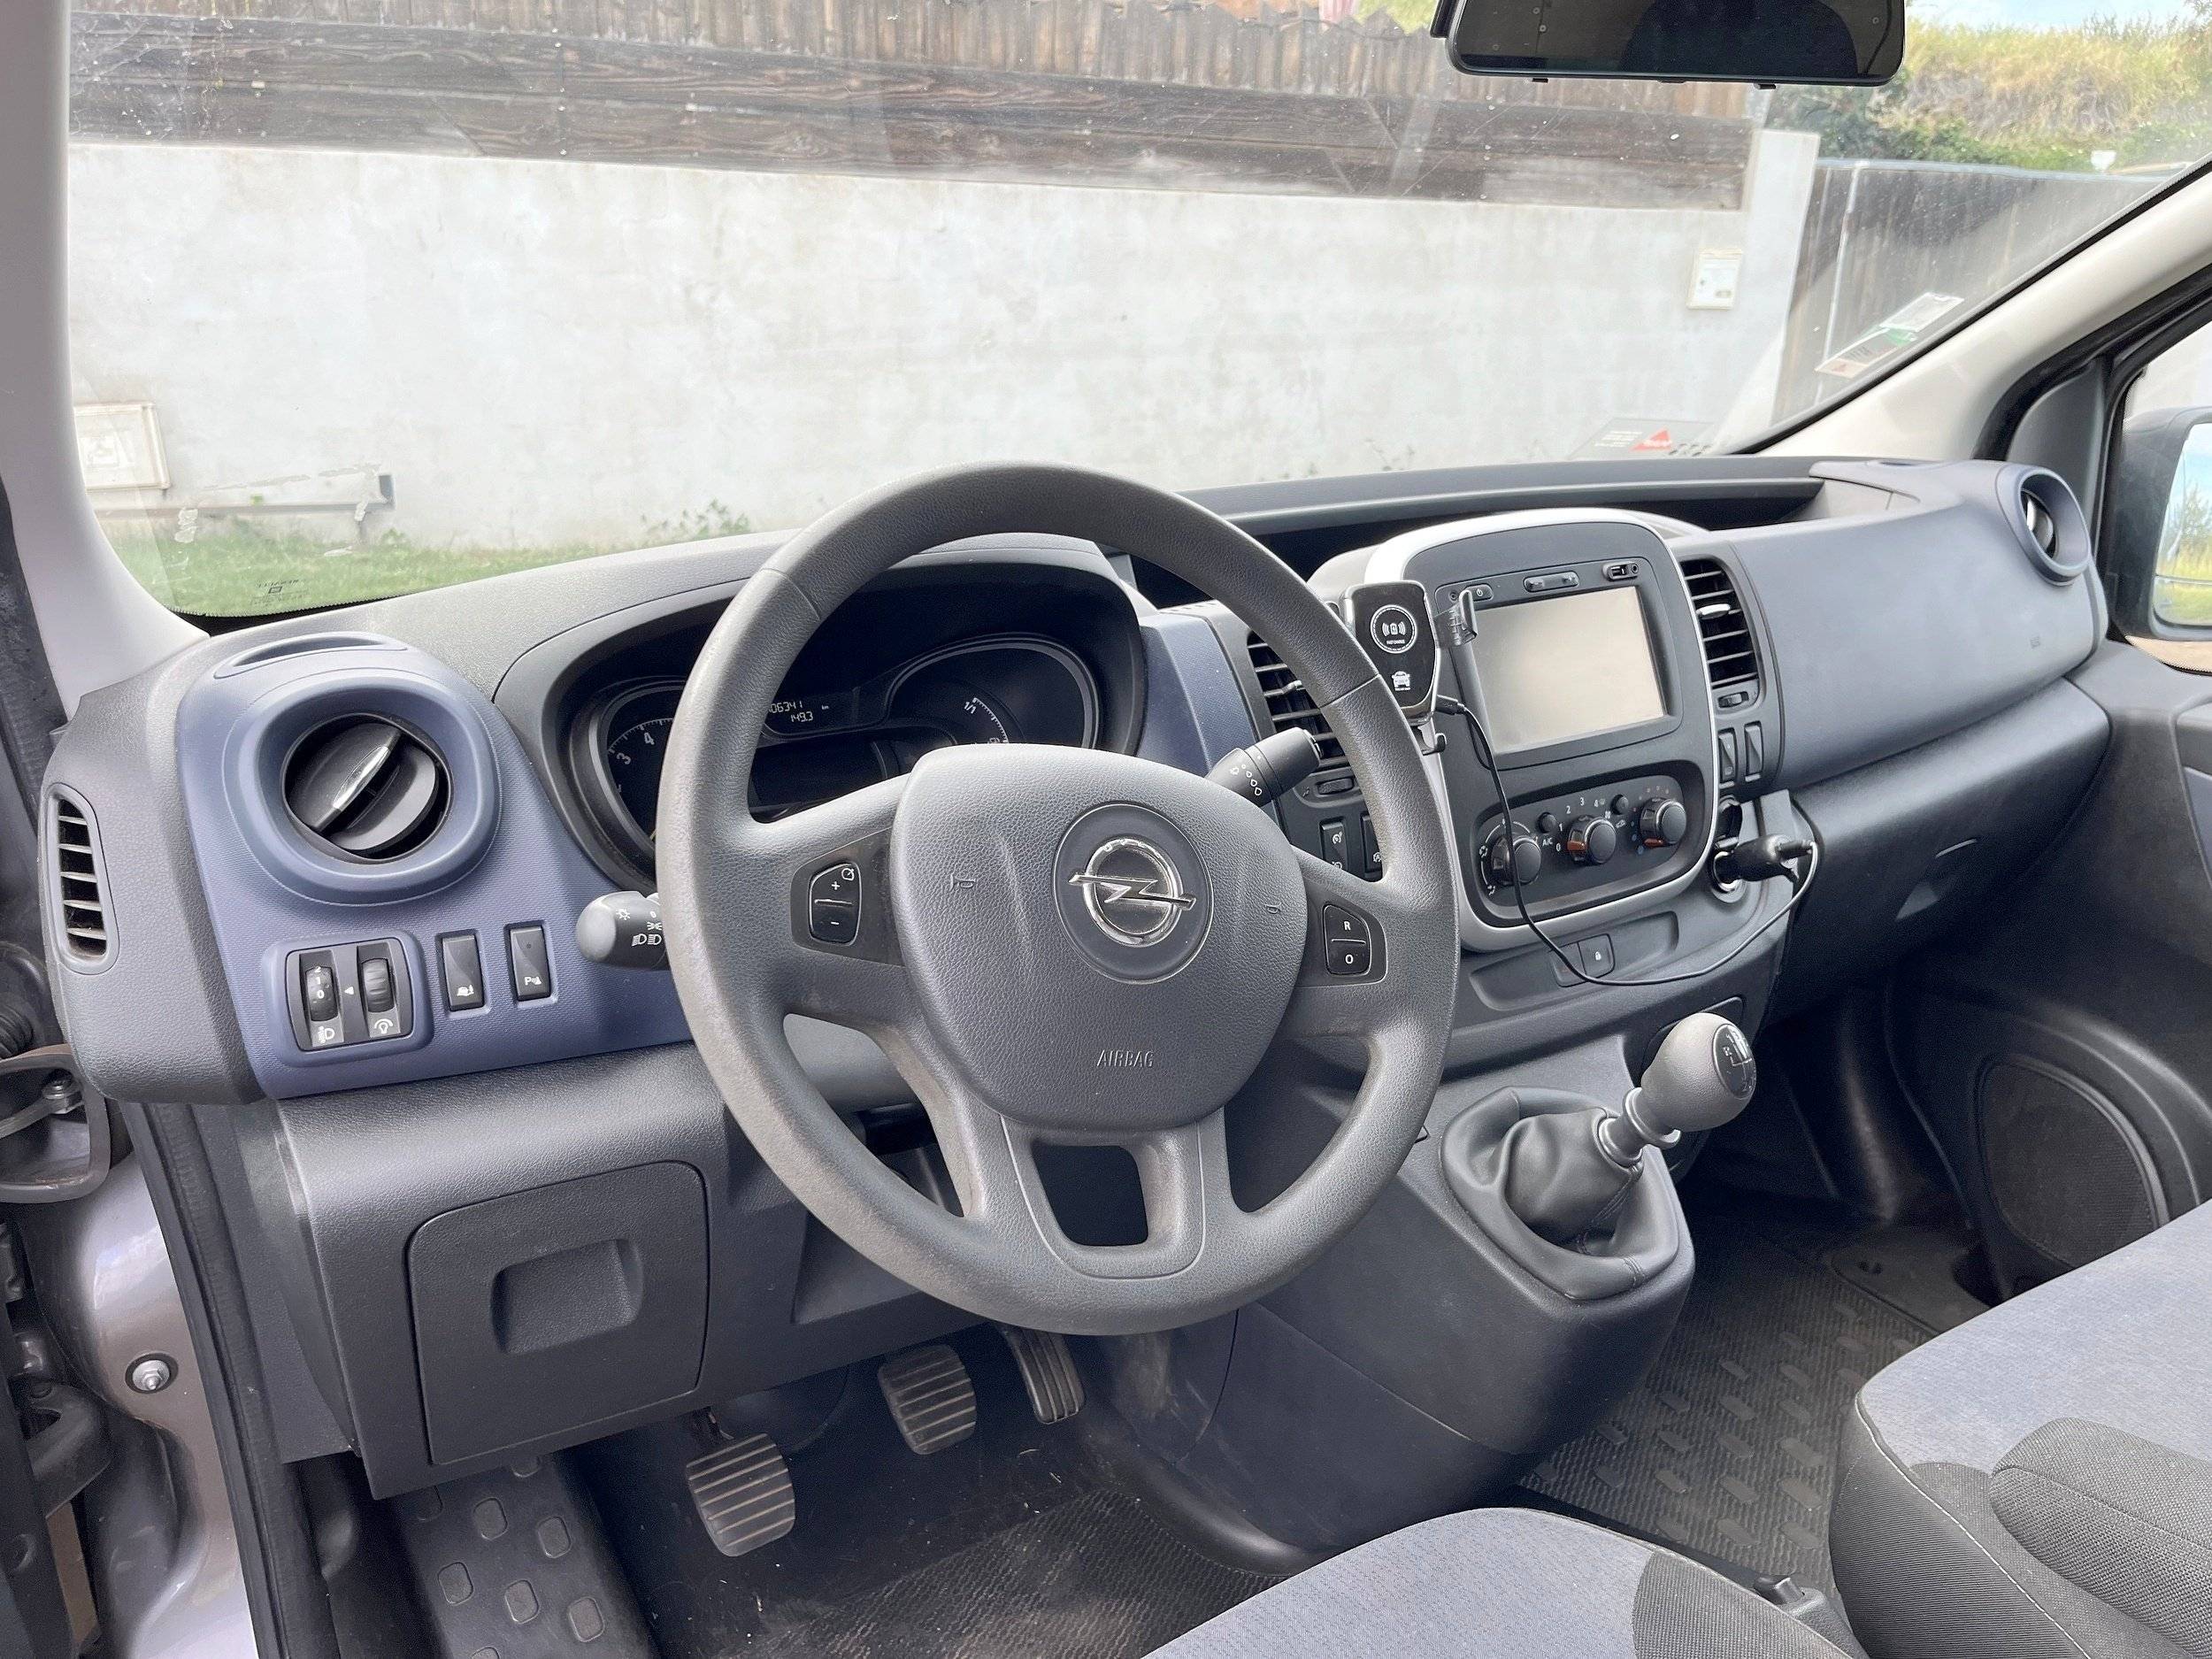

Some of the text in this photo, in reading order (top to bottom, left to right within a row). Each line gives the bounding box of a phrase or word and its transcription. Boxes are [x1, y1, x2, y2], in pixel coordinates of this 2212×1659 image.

[769, 701, 803, 713] 06341
[643, 732, 655, 745] 4
[616, 752, 631, 764] 3
[1579, 797, 1585, 806] 3
[1566, 805, 1571, 814] 2
[1558, 823, 1563, 832] 1
[1542, 837, 1553, 846] A/C
[1343, 921, 1351, 930] R
[1096, 1049, 1154, 1068] AIRBAG
